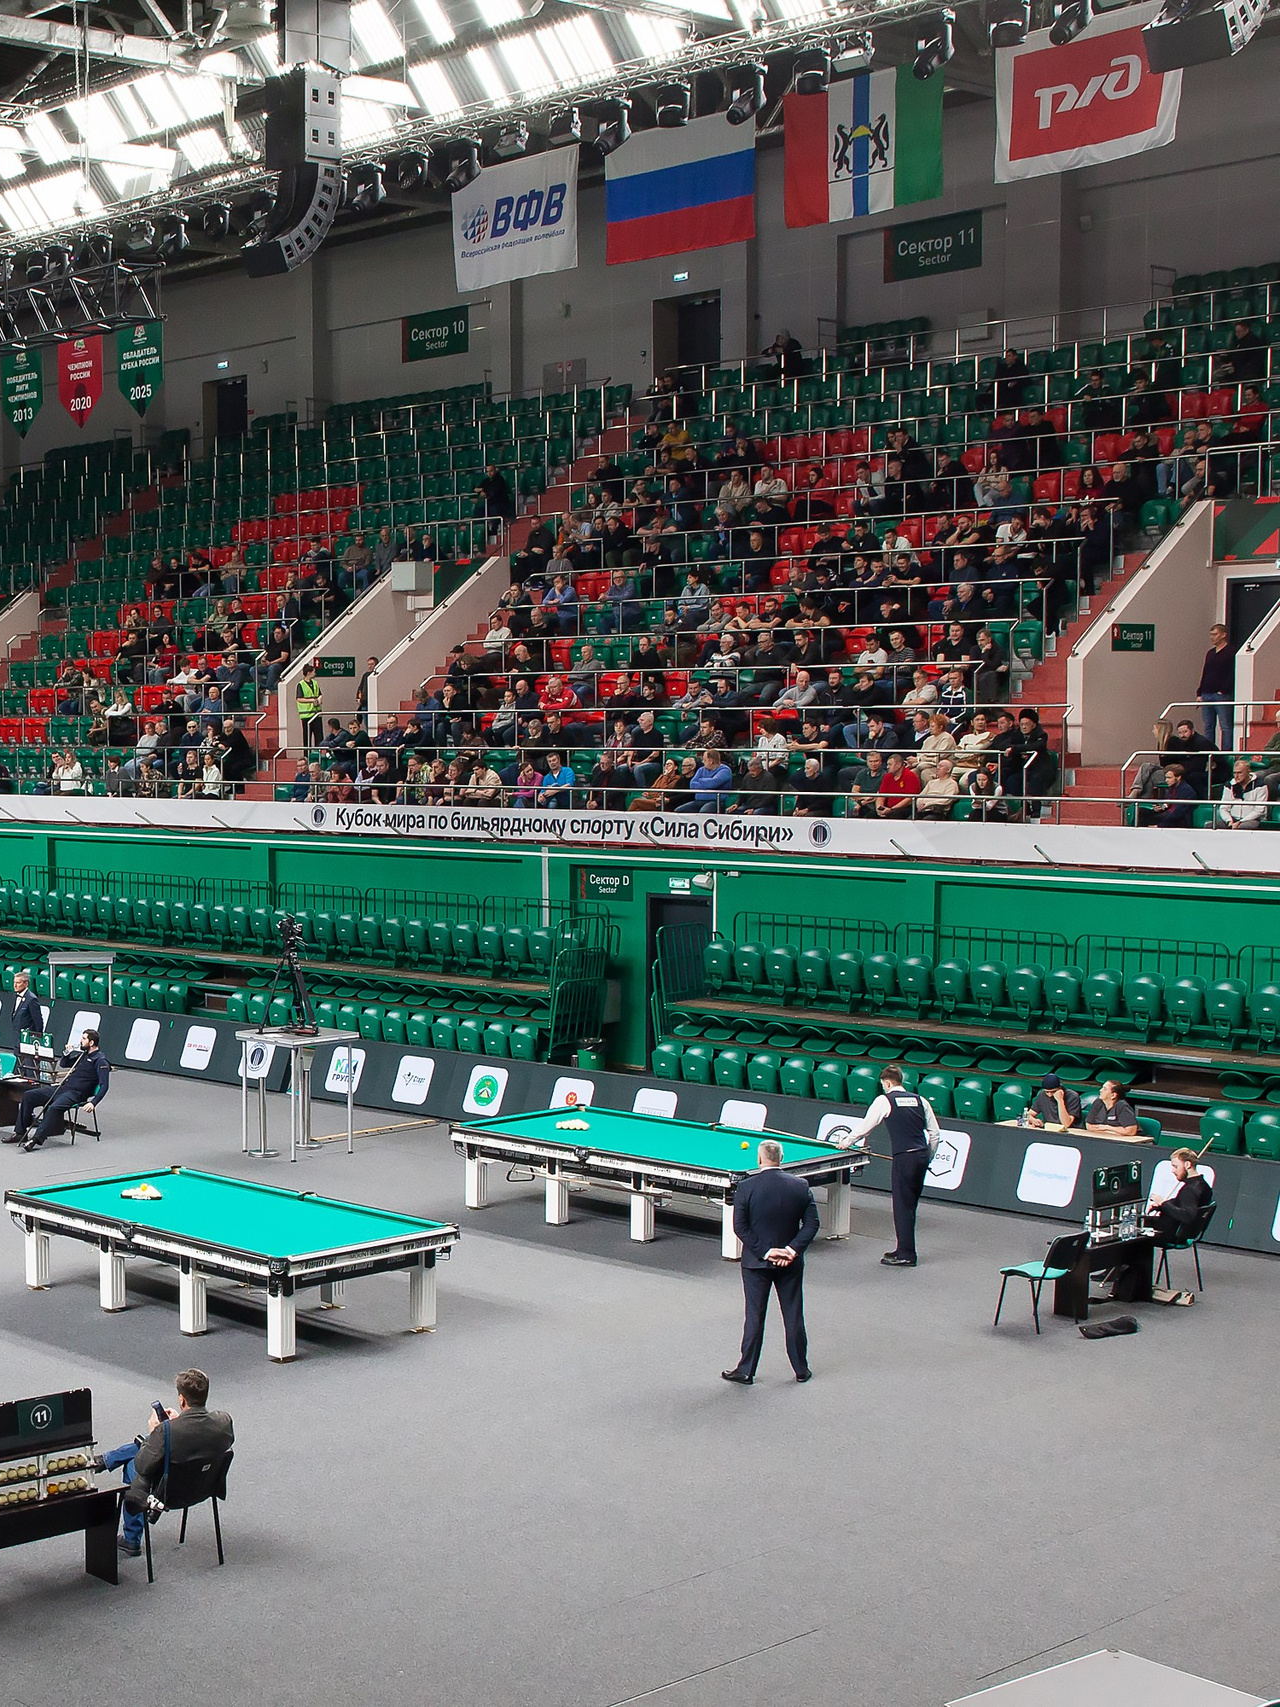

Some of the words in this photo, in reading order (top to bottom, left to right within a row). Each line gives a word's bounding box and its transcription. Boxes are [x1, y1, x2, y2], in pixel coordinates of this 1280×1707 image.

[490, 183, 567, 239] ВФВ
[898, 236, 953, 257] Сектор
[958, 227, 975, 247] 11
[461, 242, 501, 259] Всероссийская
[918, 252, 952, 267] Sector
[411, 326, 450, 342] Сектор
[453, 320, 465, 334] 10
[425, 339, 448, 351] Sector
[123, 347, 158, 360] ОБЛАДАТЕЛЬ
[67, 360, 93, 371] ЧЕМПИОН
[120, 360, 138, 371] КУБКА
[138, 356, 160, 367] РОССИИ
[6, 372, 37, 385] ПОБЕДИТЕЛЬ
[70, 371, 91, 381] РОССИИ
[15, 383, 29, 393] ЛИГИ
[130, 384, 152, 400] 2025
[70, 396, 92, 412] 2020
[13, 407, 33, 423] 2013
[1145, 630, 1152, 640] 11
[346, 661, 354, 669] 10
[336, 807, 381, 830] Кубок
[385, 814, 425, 834] мира
[429, 813, 448, 830] по
[451, 811, 566, 839] бильярдному
[570, 818, 635, 840] спорту
[640, 816, 700, 839] «Сила
[702, 819, 794, 847] Сибири»
[589, 874, 620, 888] Сектор
[622, 874, 630, 886] D
[598, 886, 617, 894] Sector
[22, 1032, 28, 1043] 7
[44, 1036, 50, 1047] 3
[1099, 1171, 1106, 1186] 2
[1131, 1165, 1138, 1180] 6
[1113, 1181, 1118, 1189] 4
[34, 1410, 47, 1423] 11
